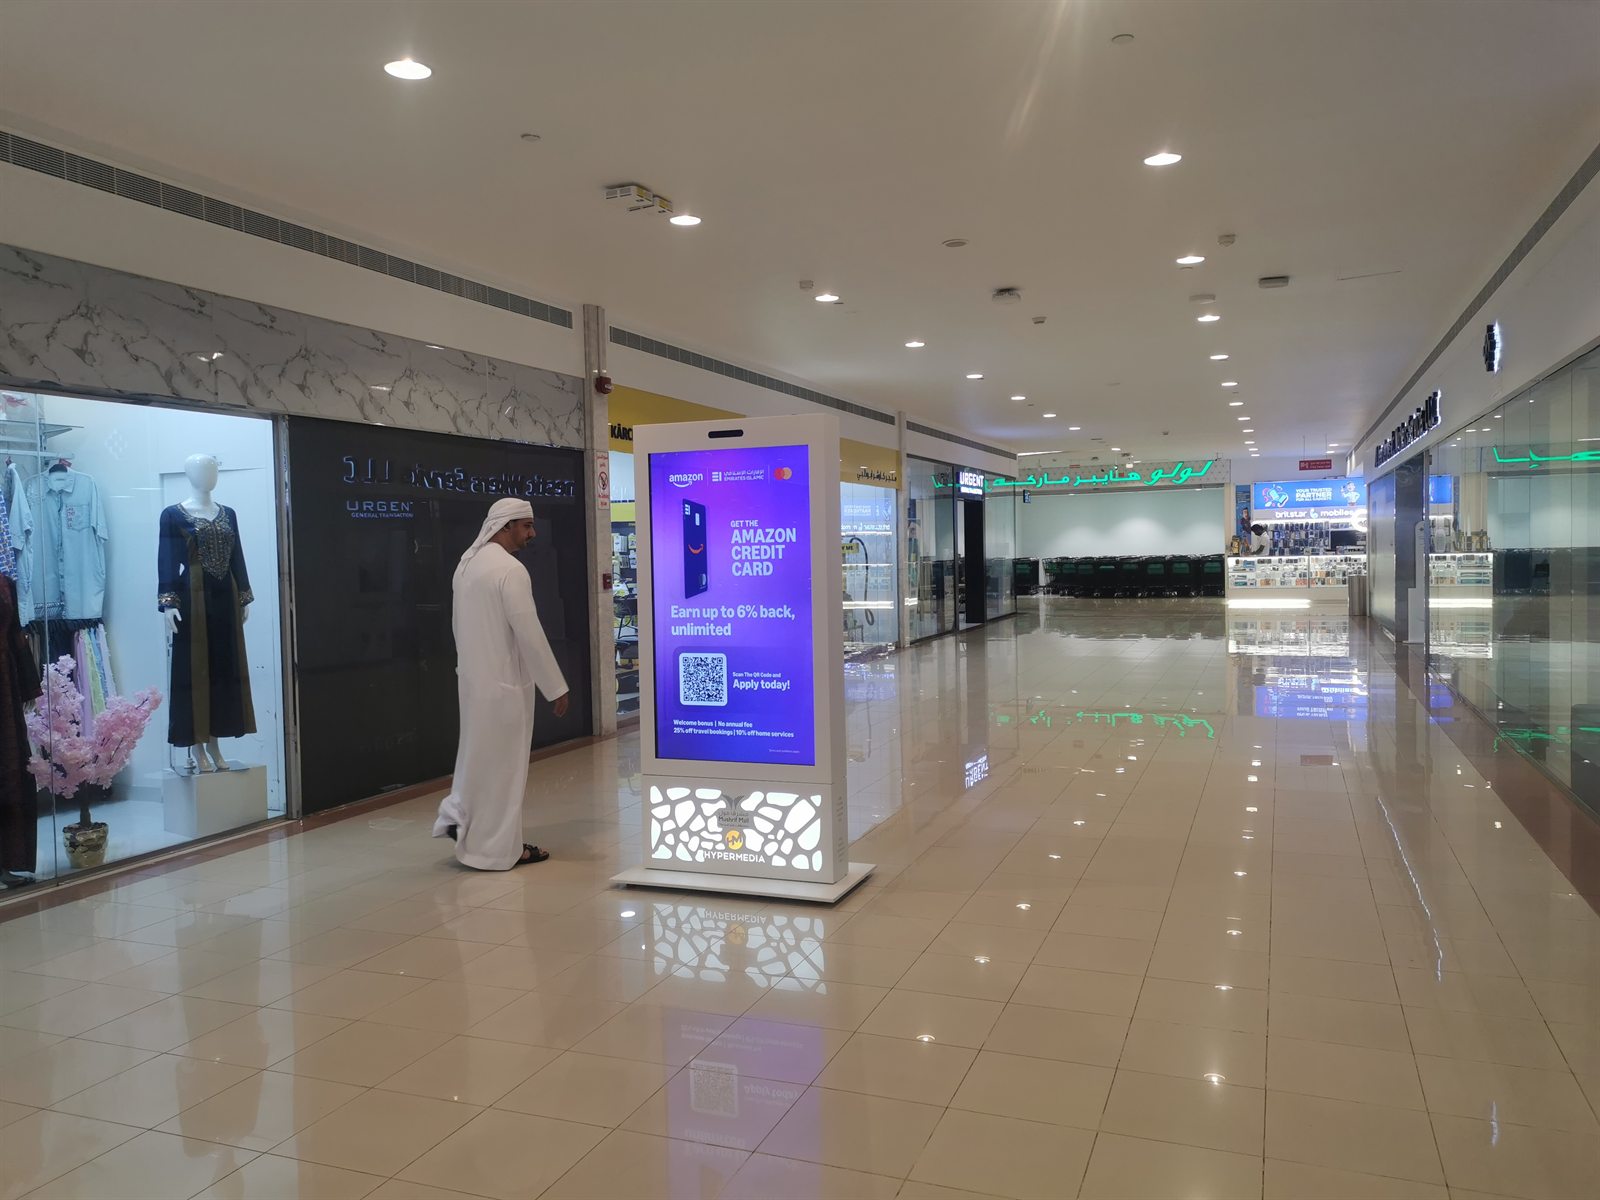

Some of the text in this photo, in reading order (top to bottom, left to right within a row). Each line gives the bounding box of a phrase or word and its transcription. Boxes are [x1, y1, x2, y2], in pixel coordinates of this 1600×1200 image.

[669, 473, 704, 483] amazon
[960, 472, 984, 487] URGENT
[1015, 472, 1071, 488] مارك
[1073, 469, 1142, 487] هايبر
[1144, 460, 1215, 485] لولو
[346, 500, 414, 512] URGEN
[731, 528, 796, 544] AMAZON
[732, 545, 785, 560] CREDIT
[732, 562, 774, 576] CARD
[671, 605, 795, 620] Earn up to 6% back,
[672, 623, 732, 636] unlimited
[733, 679, 790, 691] Apply today!
[704, 851, 766, 863] HYPERMEDIA
